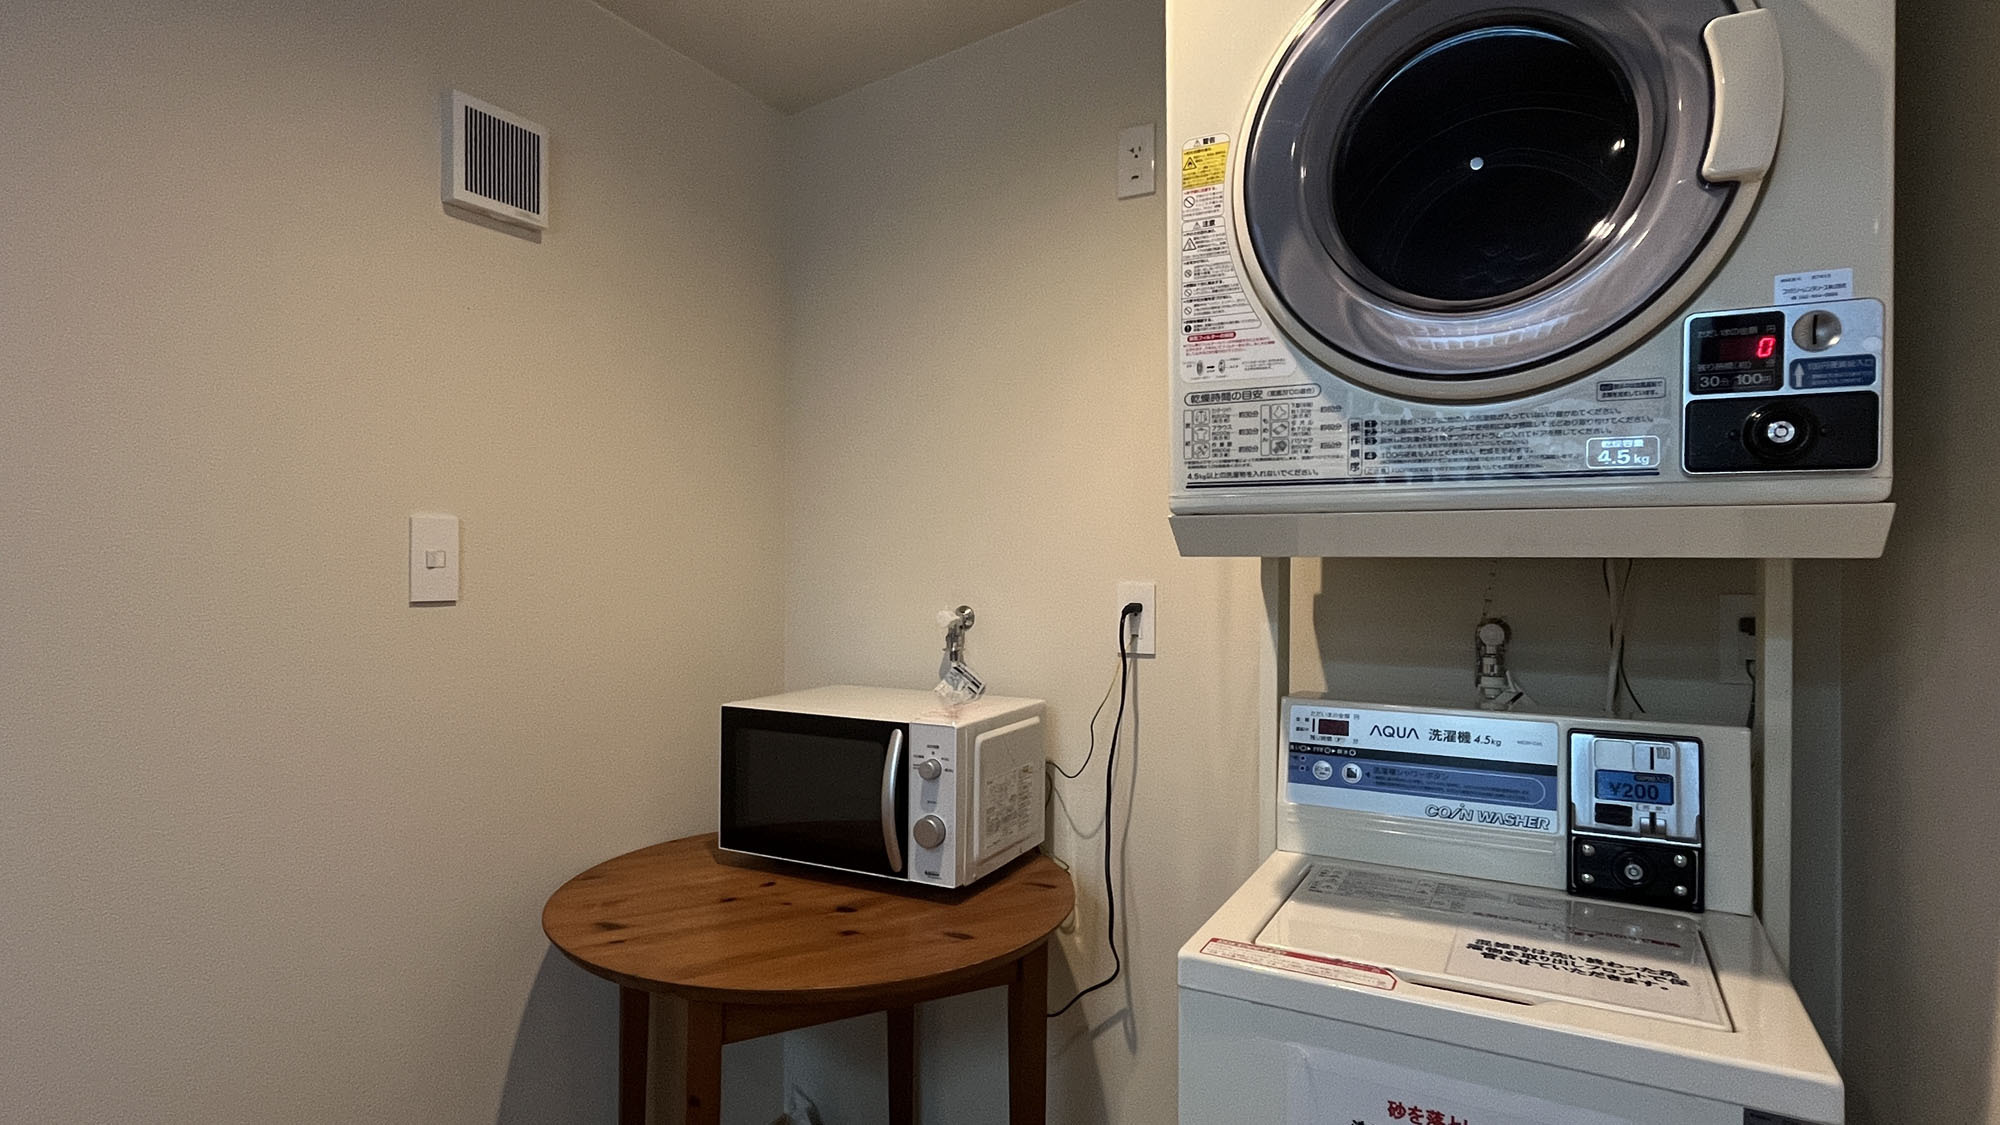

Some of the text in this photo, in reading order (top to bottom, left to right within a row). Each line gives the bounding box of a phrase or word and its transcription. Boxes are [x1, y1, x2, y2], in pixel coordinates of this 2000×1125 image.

[1756, 337, 1776, 358] 0
[1598, 449, 1630, 464] 4.5
[1369, 725, 1420, 740] AQUA
[1428, 728, 1502, 747] 洗濯機 4.5kg
[1425, 803, 1550, 831] COIN WASHER
[1387, 1100, 1468, 1125] 砂を落
